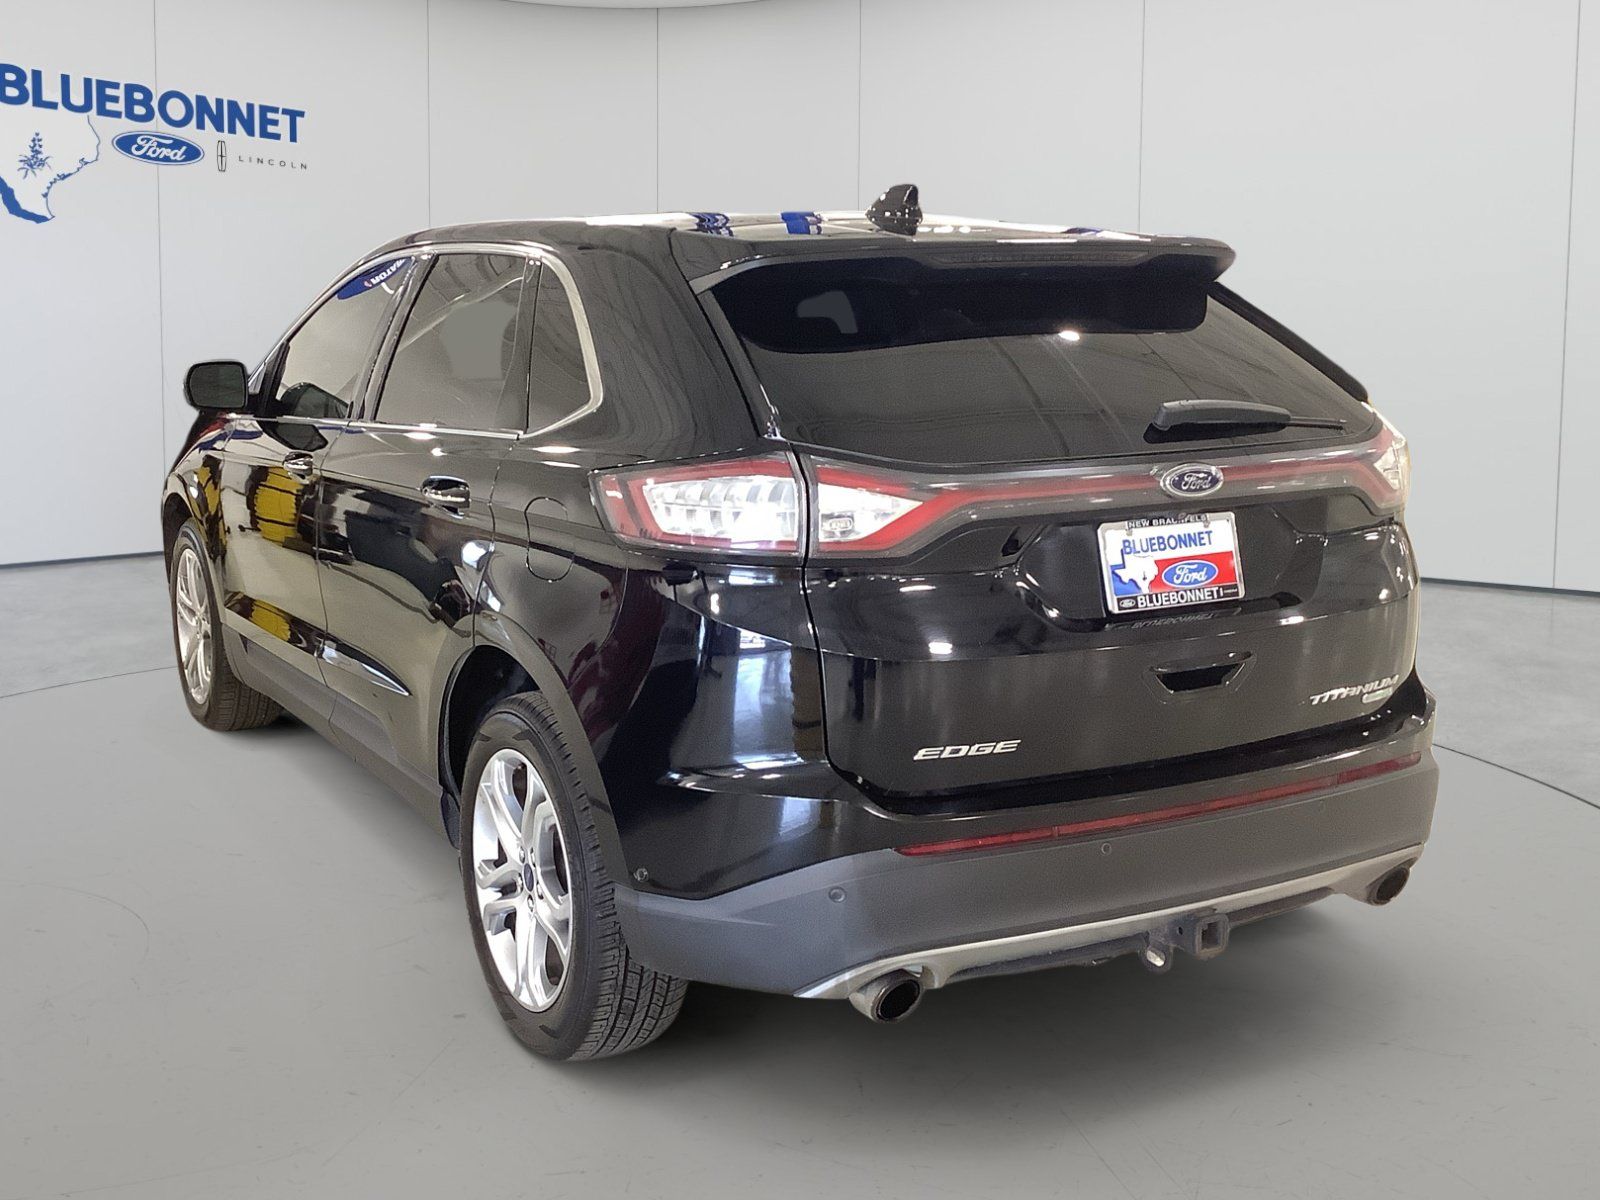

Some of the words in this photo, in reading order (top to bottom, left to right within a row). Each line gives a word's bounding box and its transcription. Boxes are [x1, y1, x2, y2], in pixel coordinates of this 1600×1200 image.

[0, 63, 305, 143] BLUEBONNET
[131, 134, 187, 162] Ford
[238, 155, 308, 170] LINCOLN
[1181, 472, 1212, 491] Ford
[1128, 518, 1150, 528] NEW
[1122, 530, 1213, 555] BLUEBONNET
[1173, 563, 1208, 584] Ford
[1137, 587, 1219, 608] BLUEBONNET
[1310, 674, 1399, 705] TITANIUM
[913, 740, 1021, 760] EDGE
